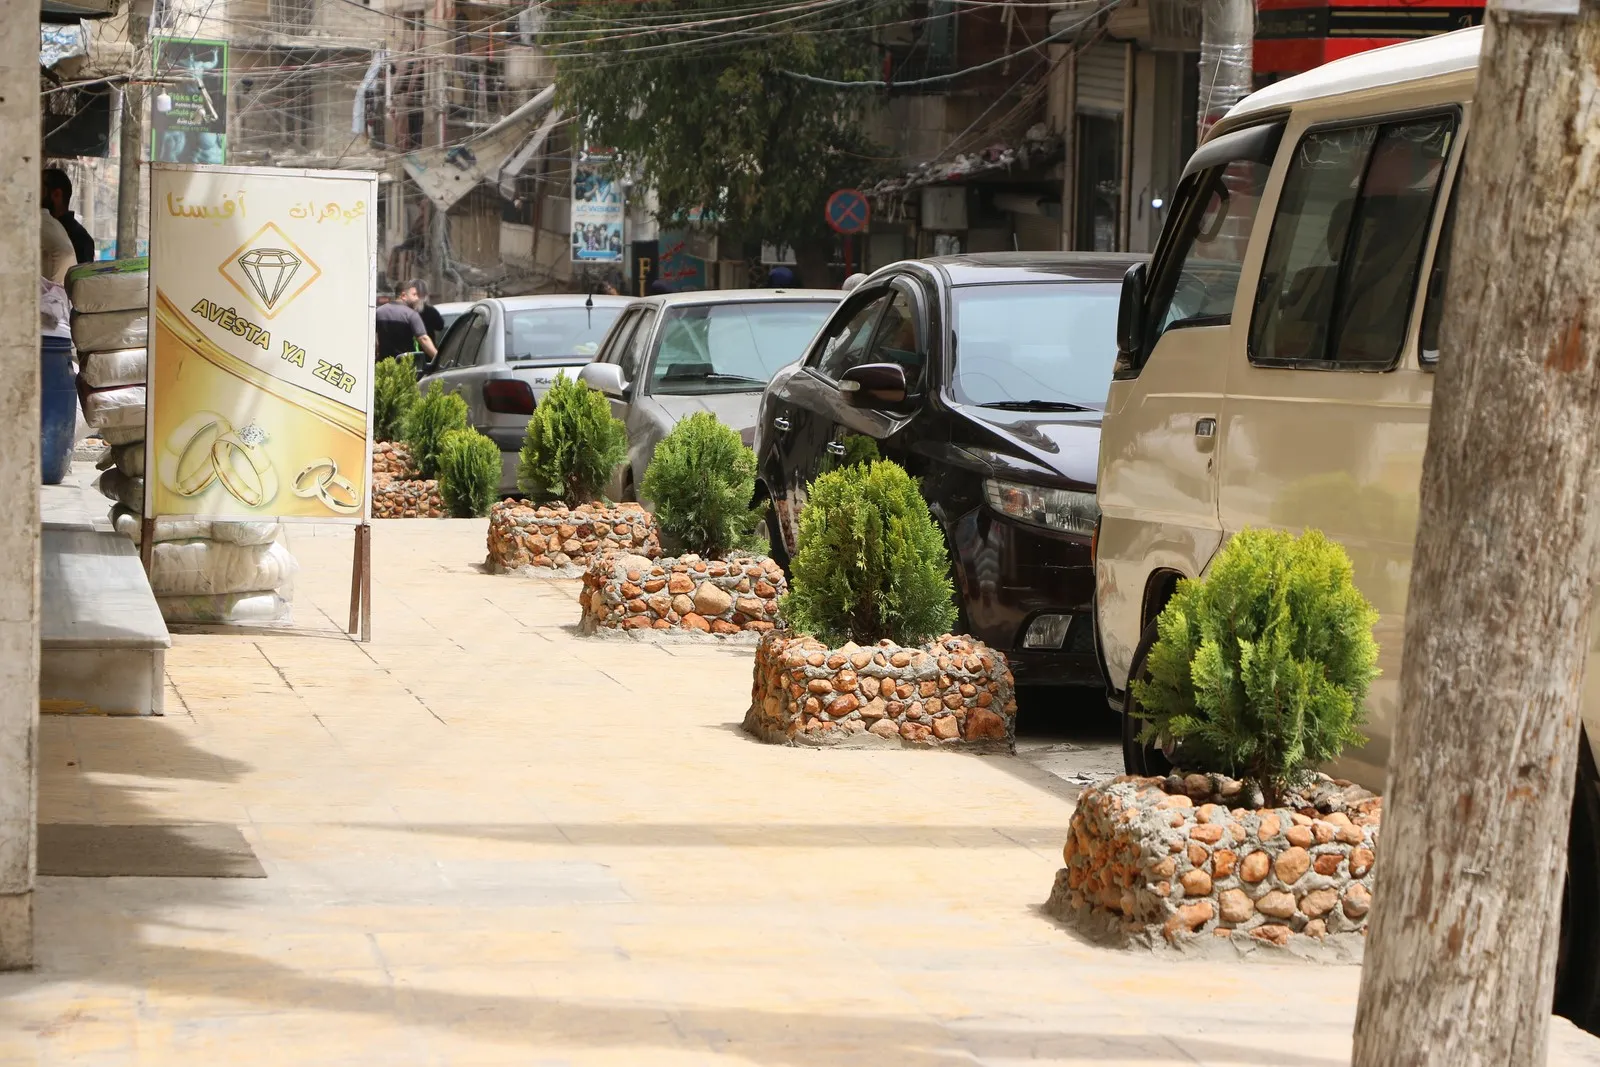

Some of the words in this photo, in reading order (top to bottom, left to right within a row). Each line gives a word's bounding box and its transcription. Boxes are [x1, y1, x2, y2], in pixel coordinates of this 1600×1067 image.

[167, 191, 247, 227] آفيستا
[289, 200, 366, 225] مجوهرات
[191, 298, 271, 350] AVÊSTA
[281, 340, 306, 367] YA
[312, 359, 356, 393] ZÊR
